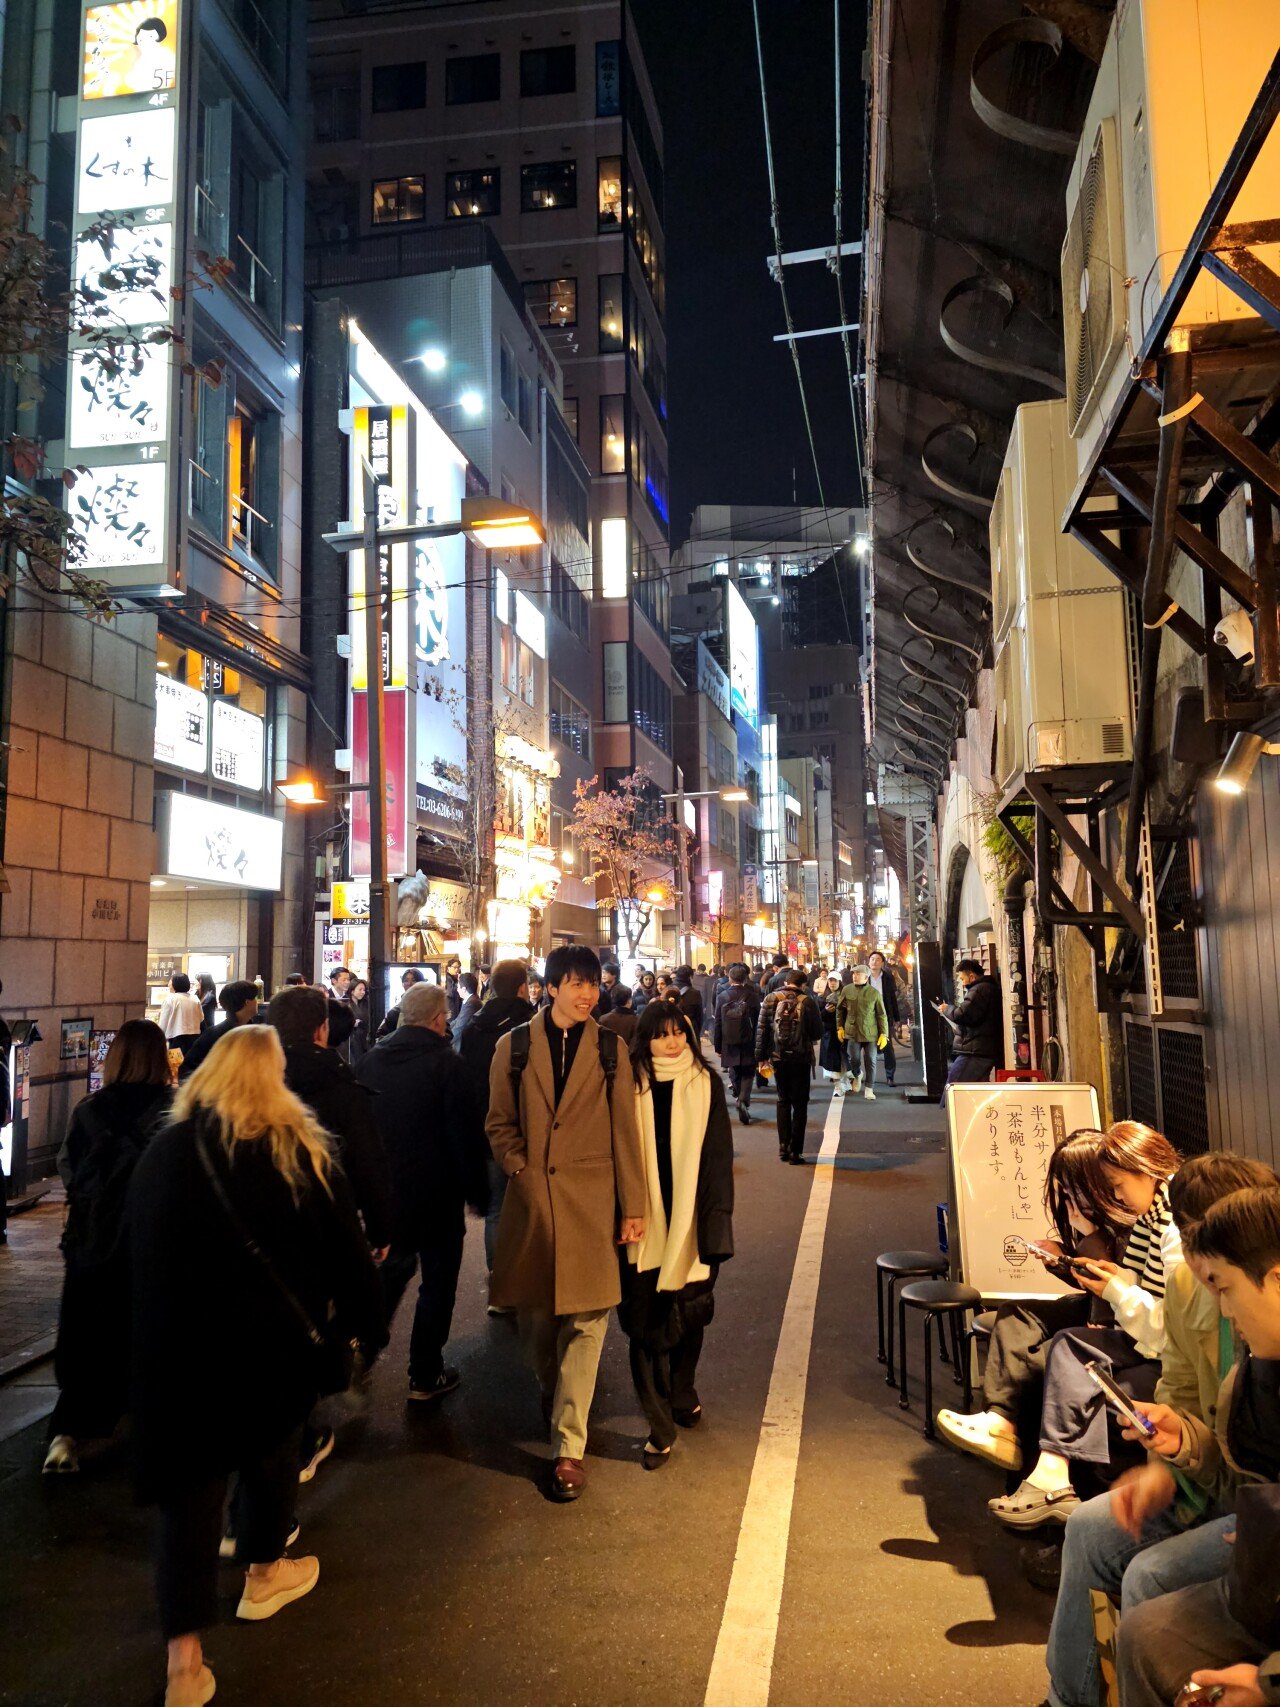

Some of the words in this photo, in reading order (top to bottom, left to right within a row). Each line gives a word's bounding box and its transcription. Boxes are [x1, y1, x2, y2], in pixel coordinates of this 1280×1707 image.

[152, 68, 174, 89] 5F
[148, 93, 169, 106] 4F
[144, 208, 166, 222] 3F
[140, 446, 159, 459] 1F
[151, 961, 175, 969] 有楽町
[985, 1104, 1006, 1181] あります。
[1005, 1104, 1034, 1220] 「茶碗もんじゃ」
